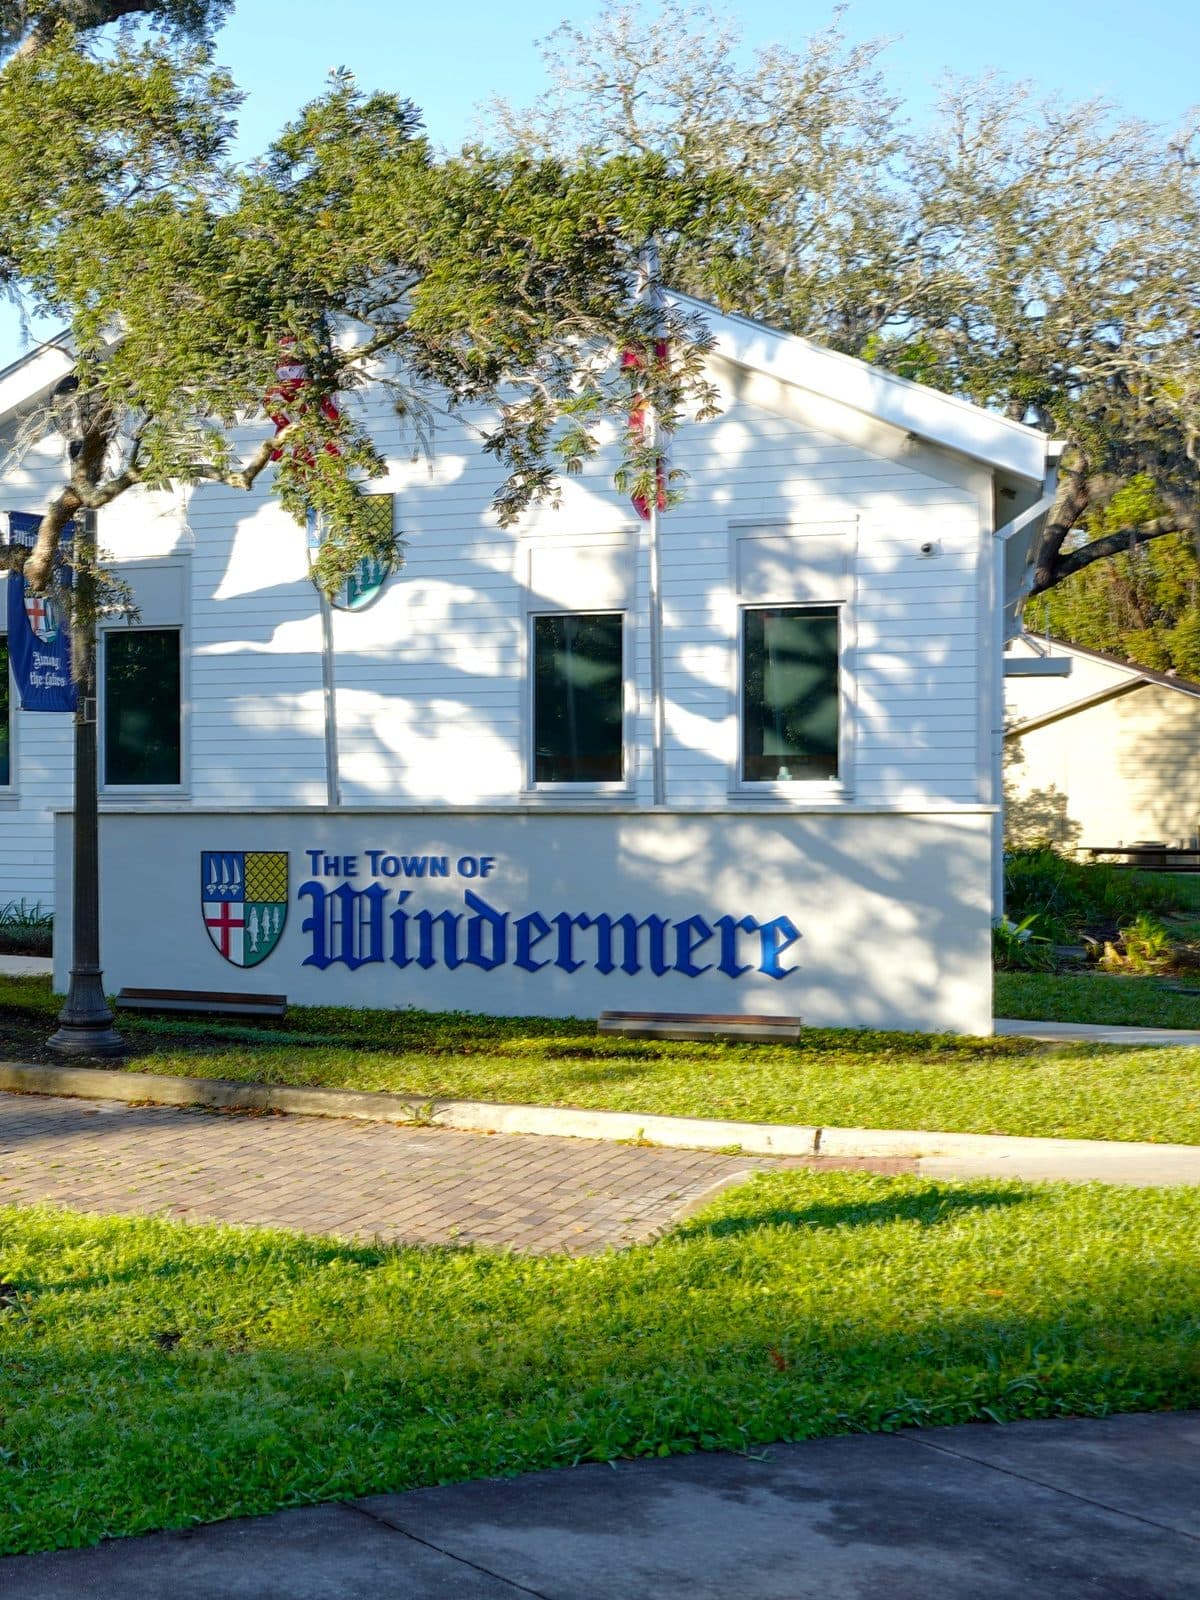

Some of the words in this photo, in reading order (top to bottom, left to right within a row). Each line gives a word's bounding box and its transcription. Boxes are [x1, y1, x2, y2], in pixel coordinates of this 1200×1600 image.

[29, 671, 44, 688] the
[457, 855, 496, 878] OF
[298, 880, 803, 980] Windermere
